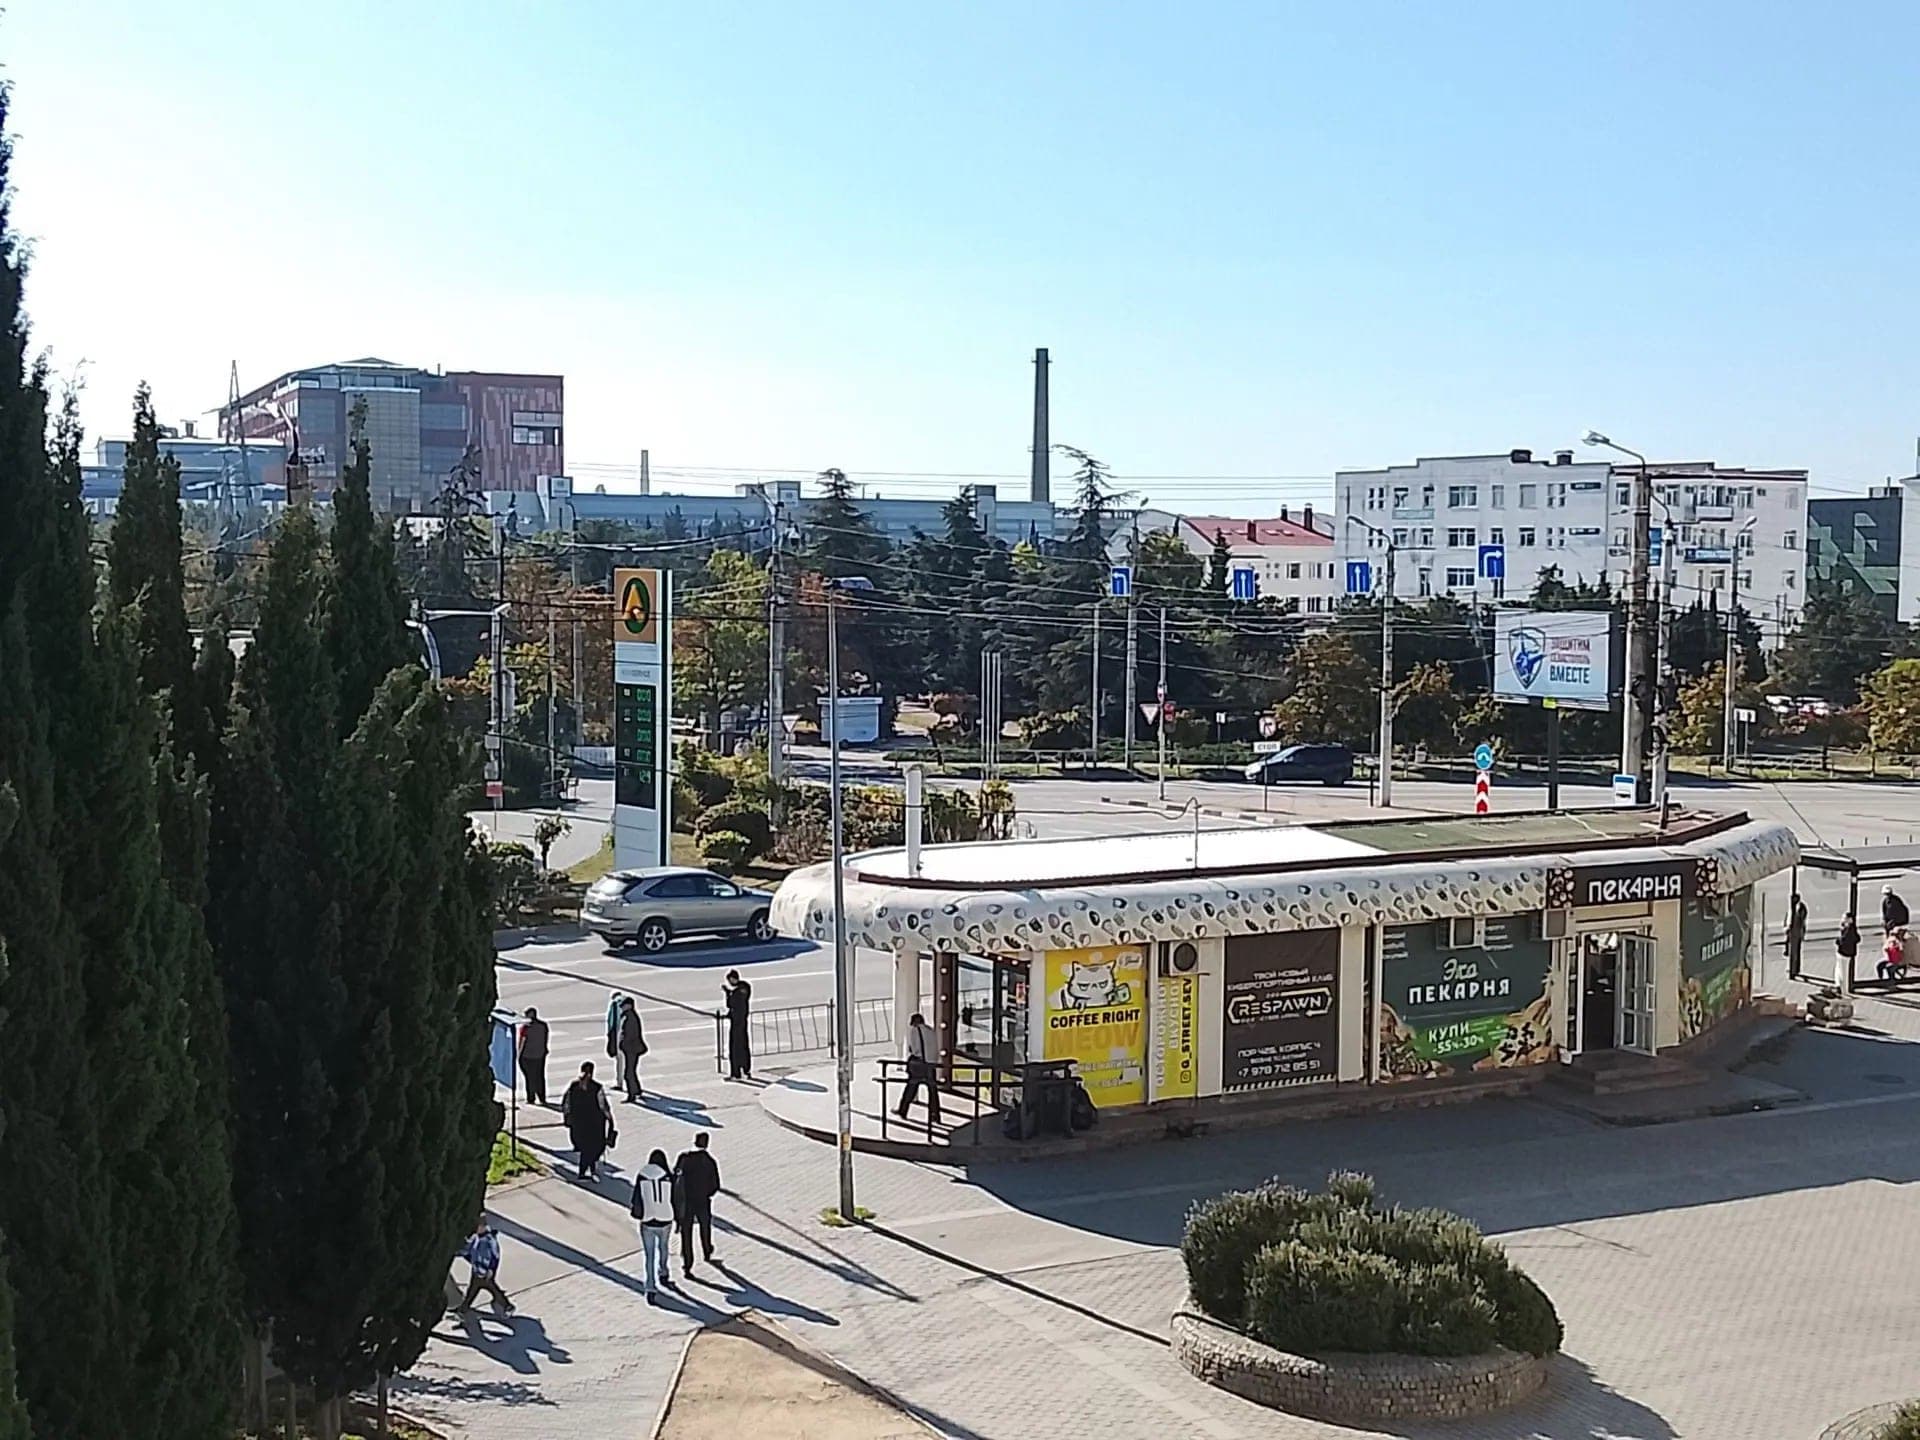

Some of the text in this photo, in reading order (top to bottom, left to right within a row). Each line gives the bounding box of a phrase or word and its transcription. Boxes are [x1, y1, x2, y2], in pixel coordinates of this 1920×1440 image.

[1549, 664, 1590, 684] ВМЕСТЕ
[1408, 978, 1511, 1005] ПЕКАРНЯ
[1239, 995, 1321, 1017] RESPAWN
[1050, 1008, 1140, 1030] COFFEE RIGHT
[1049, 1022, 1139, 1056] MEOW
[1428, 1021, 1470, 1043] КУПИ
[1238, 1067, 1249, 1078] +7
